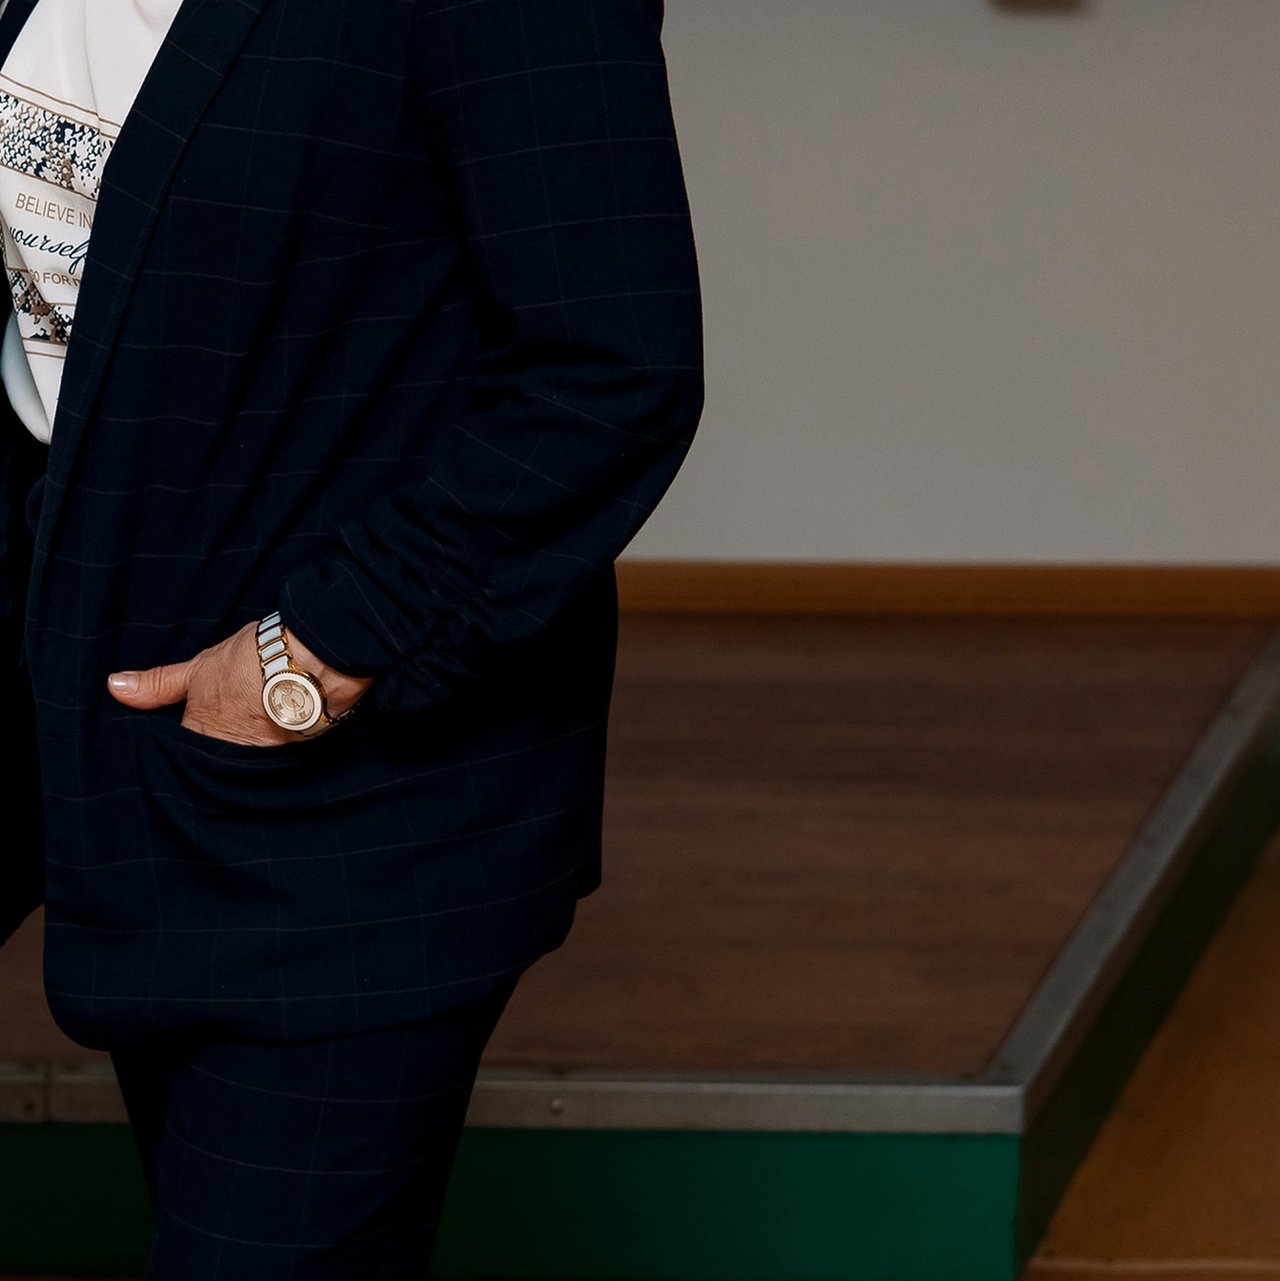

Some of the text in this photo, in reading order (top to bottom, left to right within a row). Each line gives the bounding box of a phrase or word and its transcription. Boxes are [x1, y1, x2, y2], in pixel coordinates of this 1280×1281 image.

[15, 192, 93, 230] BELIEVE IN
[43, 271, 71, 287] FOR
